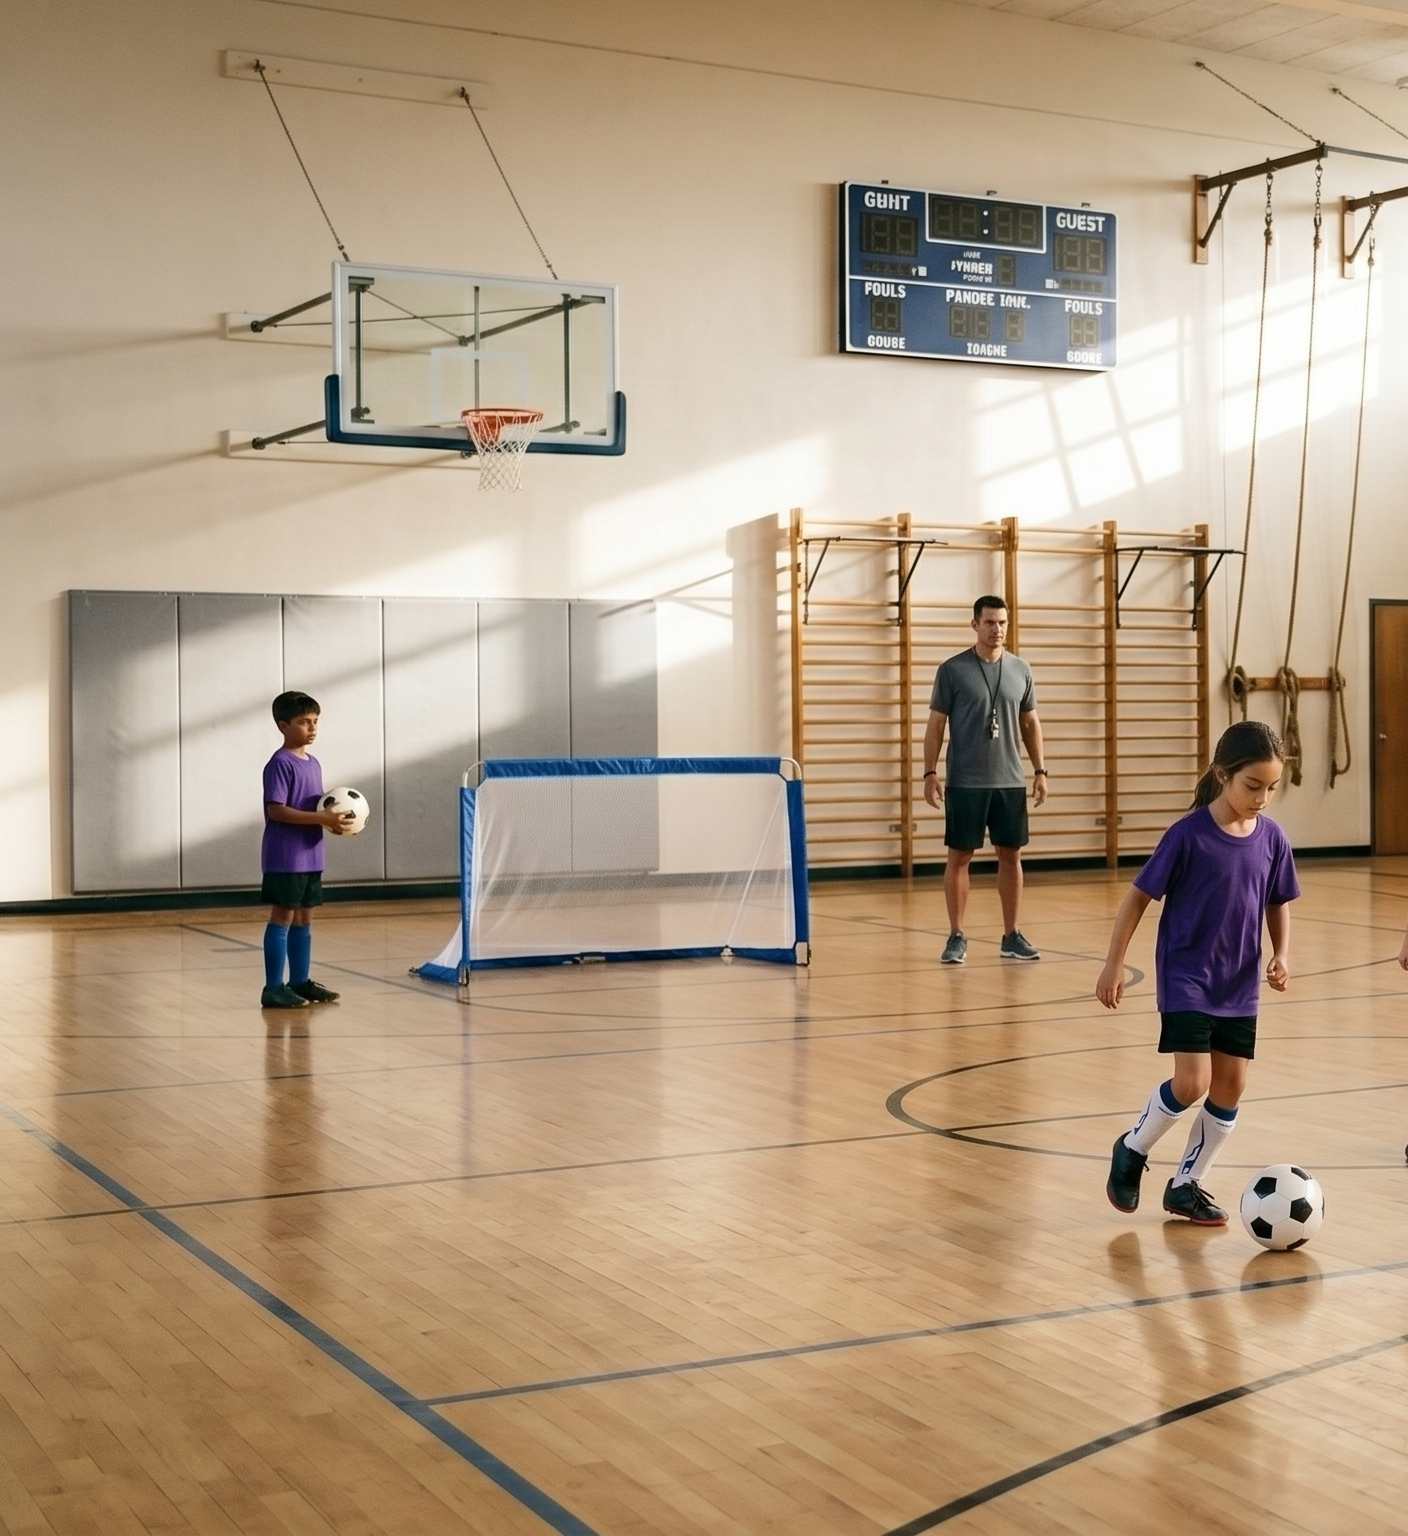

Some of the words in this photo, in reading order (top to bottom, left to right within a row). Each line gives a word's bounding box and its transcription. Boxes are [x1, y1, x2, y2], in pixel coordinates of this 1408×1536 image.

[1056, 212, 1106, 232] GUEST
[864, 281, 906, 298] FOULS
[1064, 300, 1103, 315] FOULS
